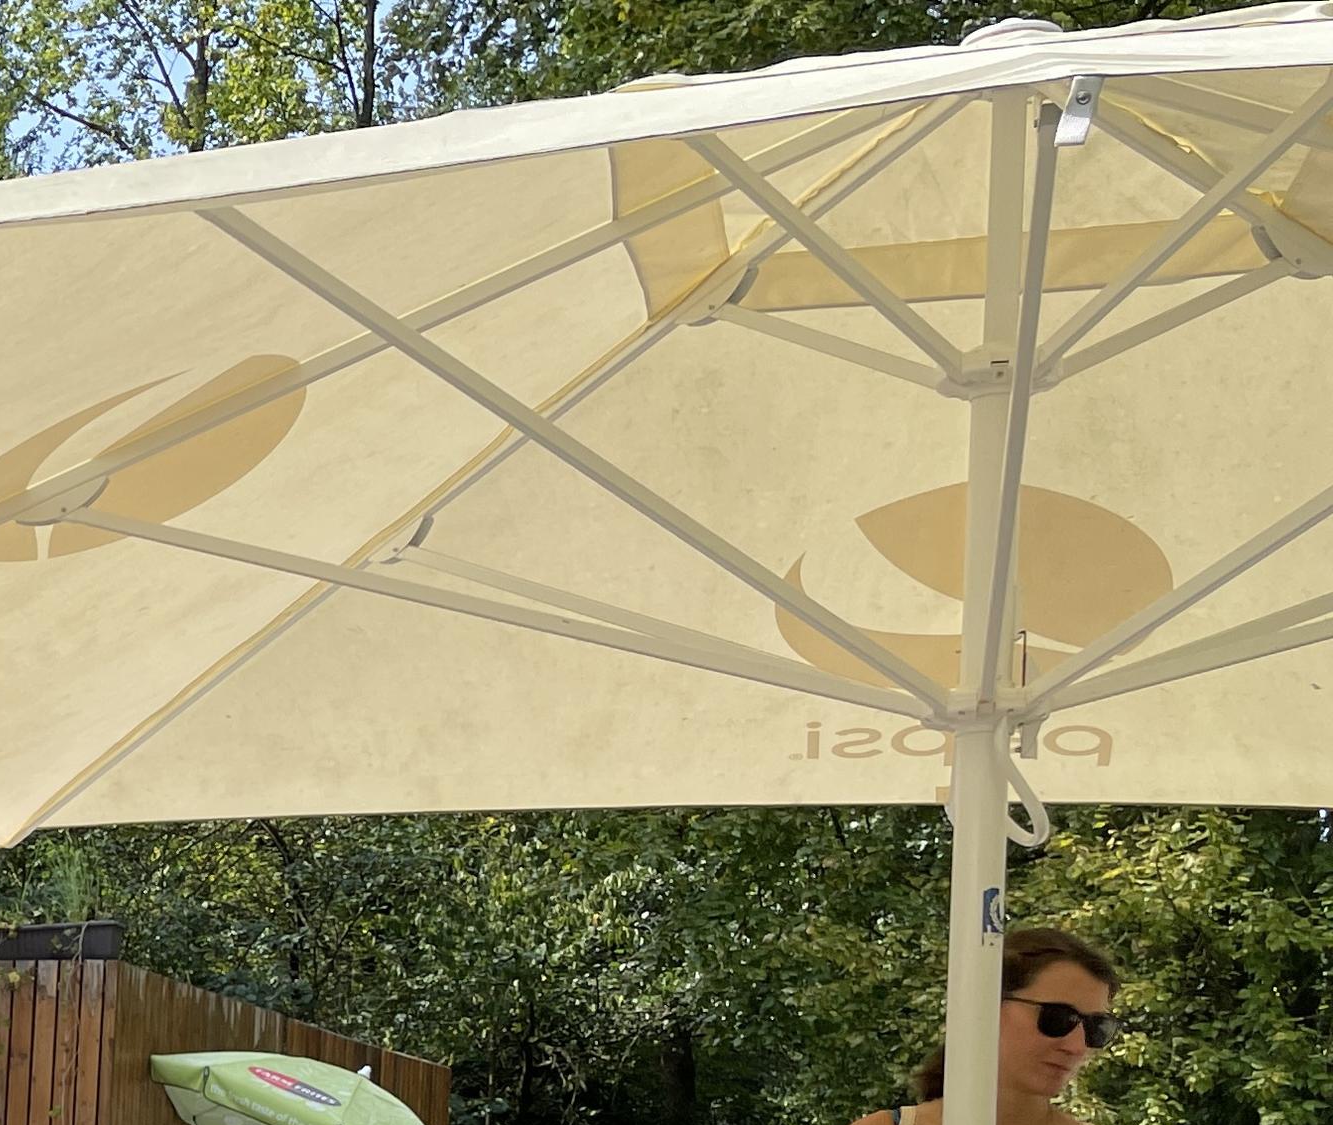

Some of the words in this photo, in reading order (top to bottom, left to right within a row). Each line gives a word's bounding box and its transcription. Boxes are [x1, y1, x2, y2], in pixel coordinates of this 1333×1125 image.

[254, 1067, 294, 1087] FARM
[293, 1084, 338, 1106] FRITES
[275, 1110, 288, 1122] of
